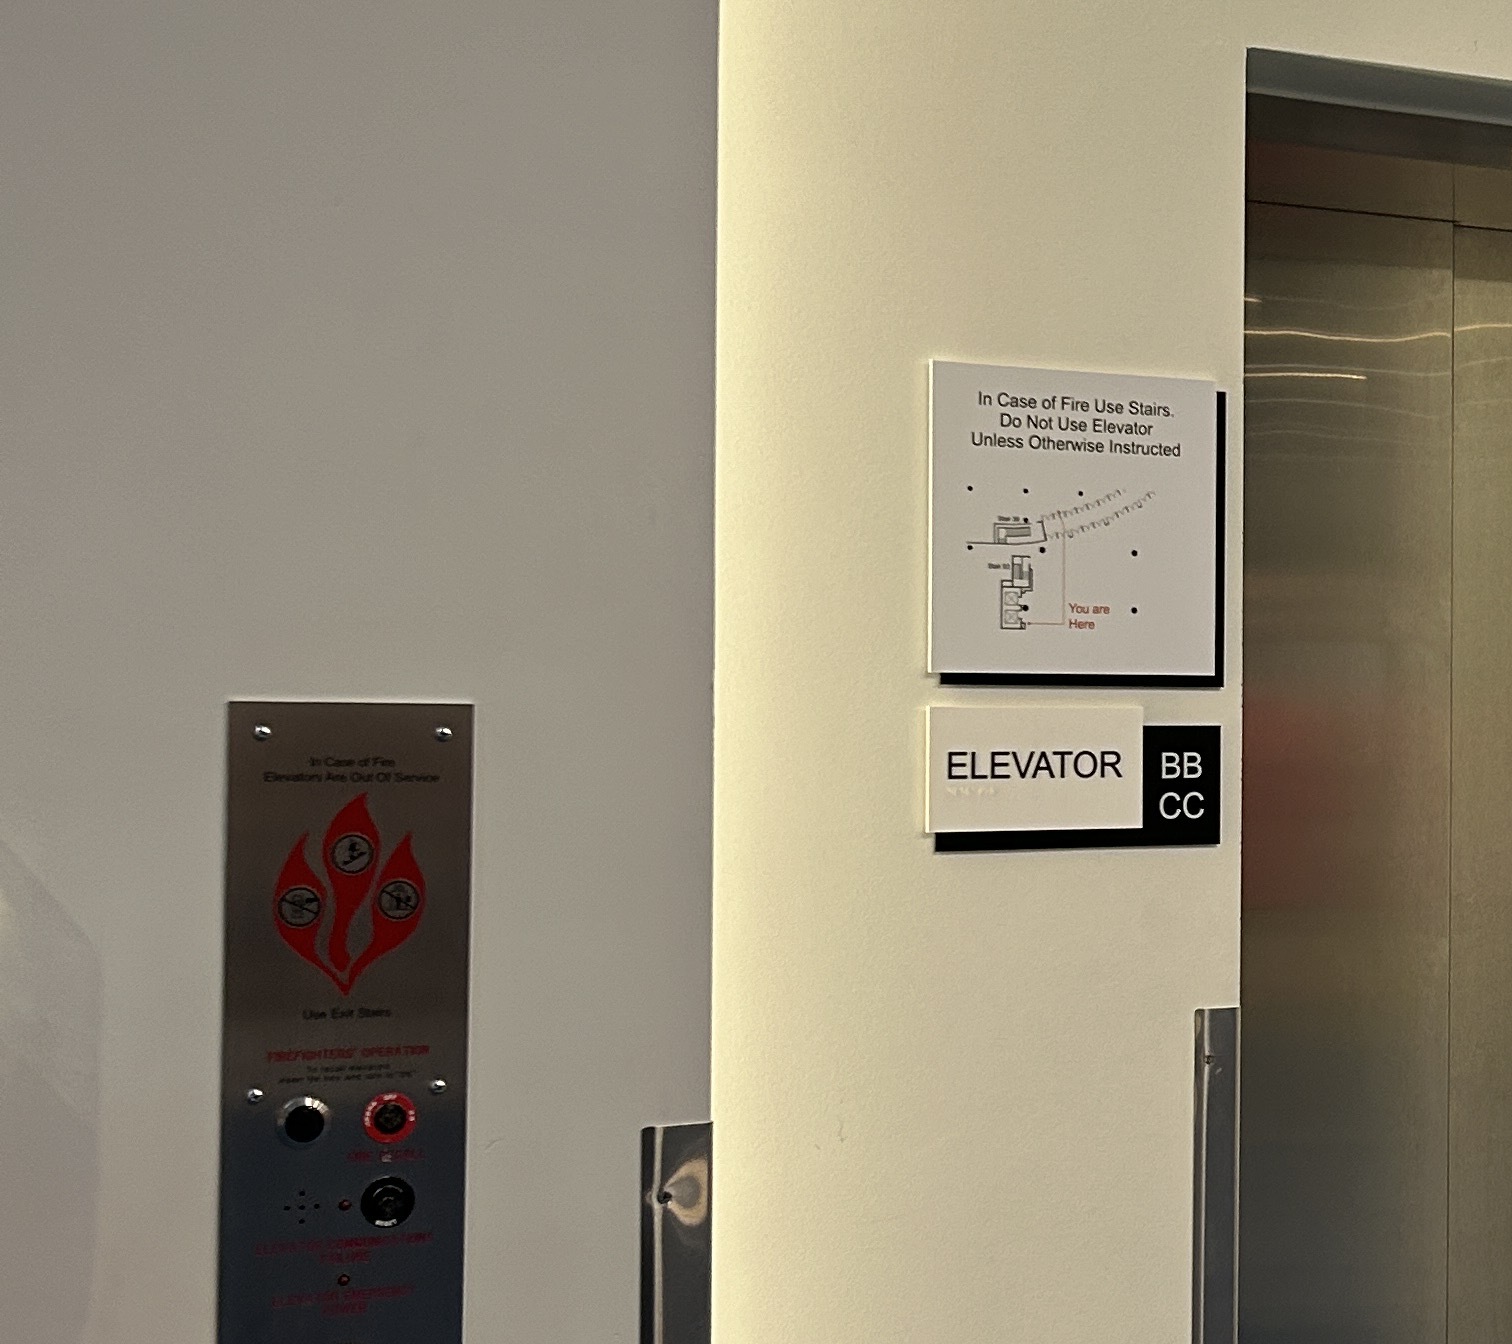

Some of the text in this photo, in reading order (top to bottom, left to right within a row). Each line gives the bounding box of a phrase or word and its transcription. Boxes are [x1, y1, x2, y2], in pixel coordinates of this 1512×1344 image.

[978, 391, 1175, 417] In Case of Fire Use Stairs.
[1000, 413, 1154, 436] Do Not Use Elevator
[971, 432, 1181, 457] Unless Otherwise Instructed
[1068, 602, 1110, 615] You are
[1068, 618, 1096, 630] Here
[947, 750, 1123, 780] ELEVATOR
[1161, 751, 1203, 780] BB
[1159, 791, 1205, 820] CC
